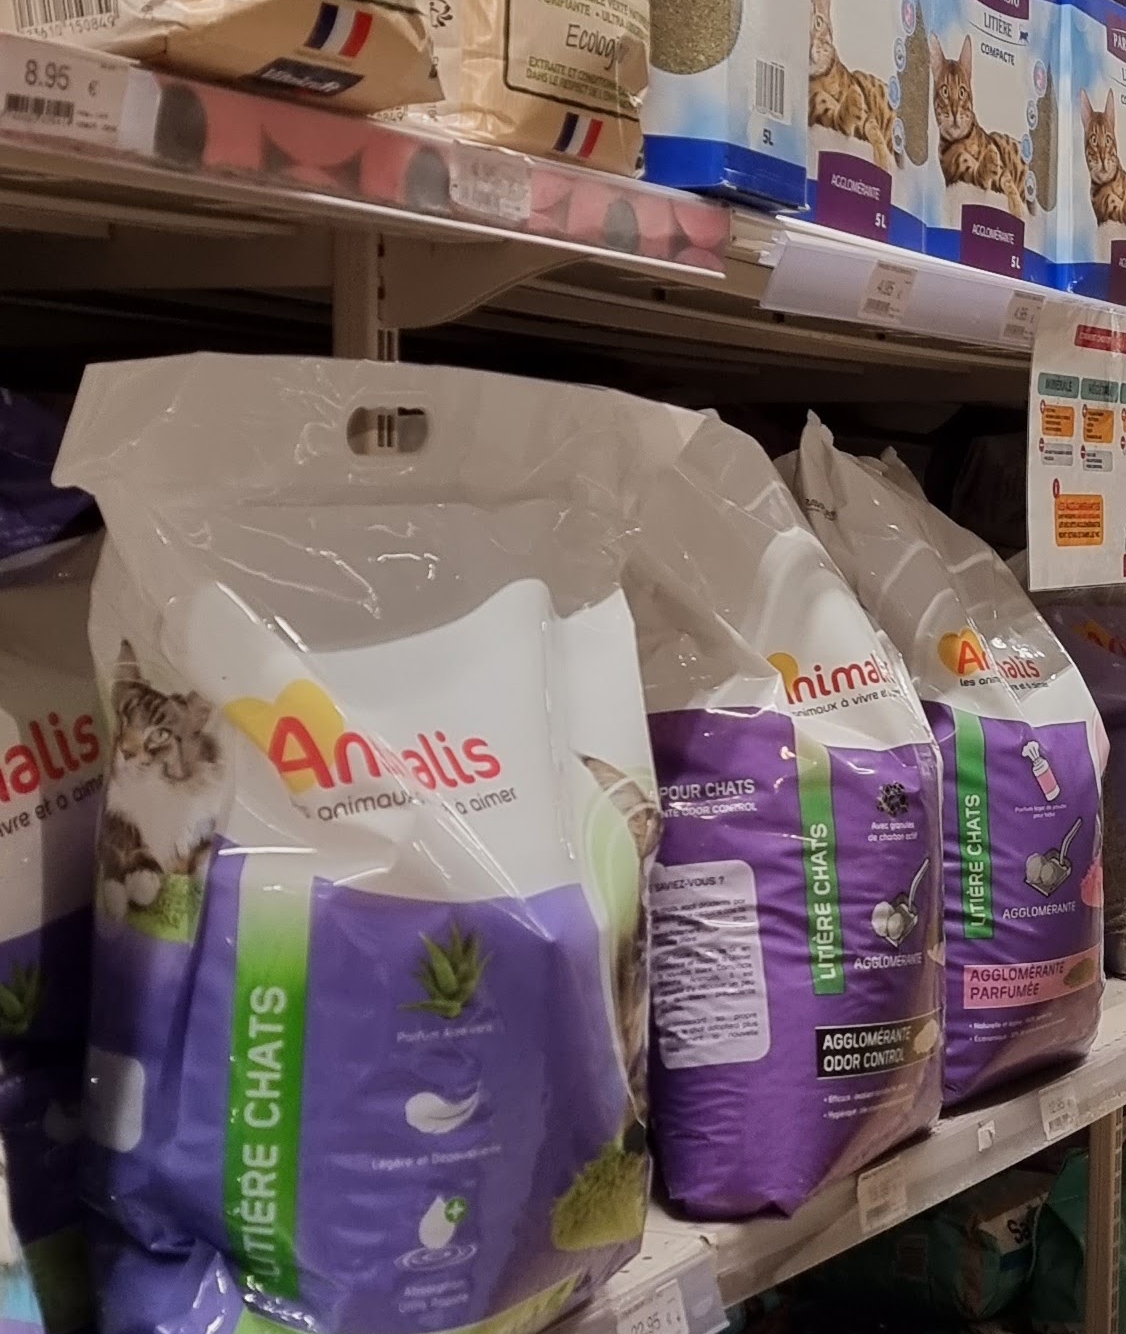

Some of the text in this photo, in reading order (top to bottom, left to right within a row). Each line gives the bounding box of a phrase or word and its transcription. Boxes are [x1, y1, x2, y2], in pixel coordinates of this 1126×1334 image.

[983, 12, 1012, 38] LITIÈRE
[980, 42, 1015, 67] COMPACTE
[24, 58, 71, 91] 8.95
[762, 128, 774, 146] 5L
[830, 172, 882, 201] AGGLOMÉRANTE
[874, 213, 887, 229] 5L
[972, 222, 1015, 246] AGGLOMÉRANTE
[1011, 255, 1021, 270] 5L
[958, 640, 1040, 679] Aalis
[852, 691, 879, 706] vivre
[267, 714, 501, 789] Analis
[469, 785, 519, 813] aimer
[659, 778, 755, 802] POUR CHATS
[964, 794, 983, 857] CHATS
[809, 822, 832, 896] CHATS
[968, 861, 986, 927] LITIÈRE
[1003, 901, 1076, 919] AGGLOMÉRANTE
[813, 901, 838, 980] LITIÈRE
[854, 952, 922, 970] AGGLOMÉRANTE
[970, 961, 1064, 983] AGGLOMÉRANTE
[970, 982, 1040, 1001] PARFUMÉE
[823, 1024, 912, 1051] AGGLOMÉRANTE
[244, 986, 287, 1128] CHATS
[824, 1047, 905, 1072] ODOR CONTROL
